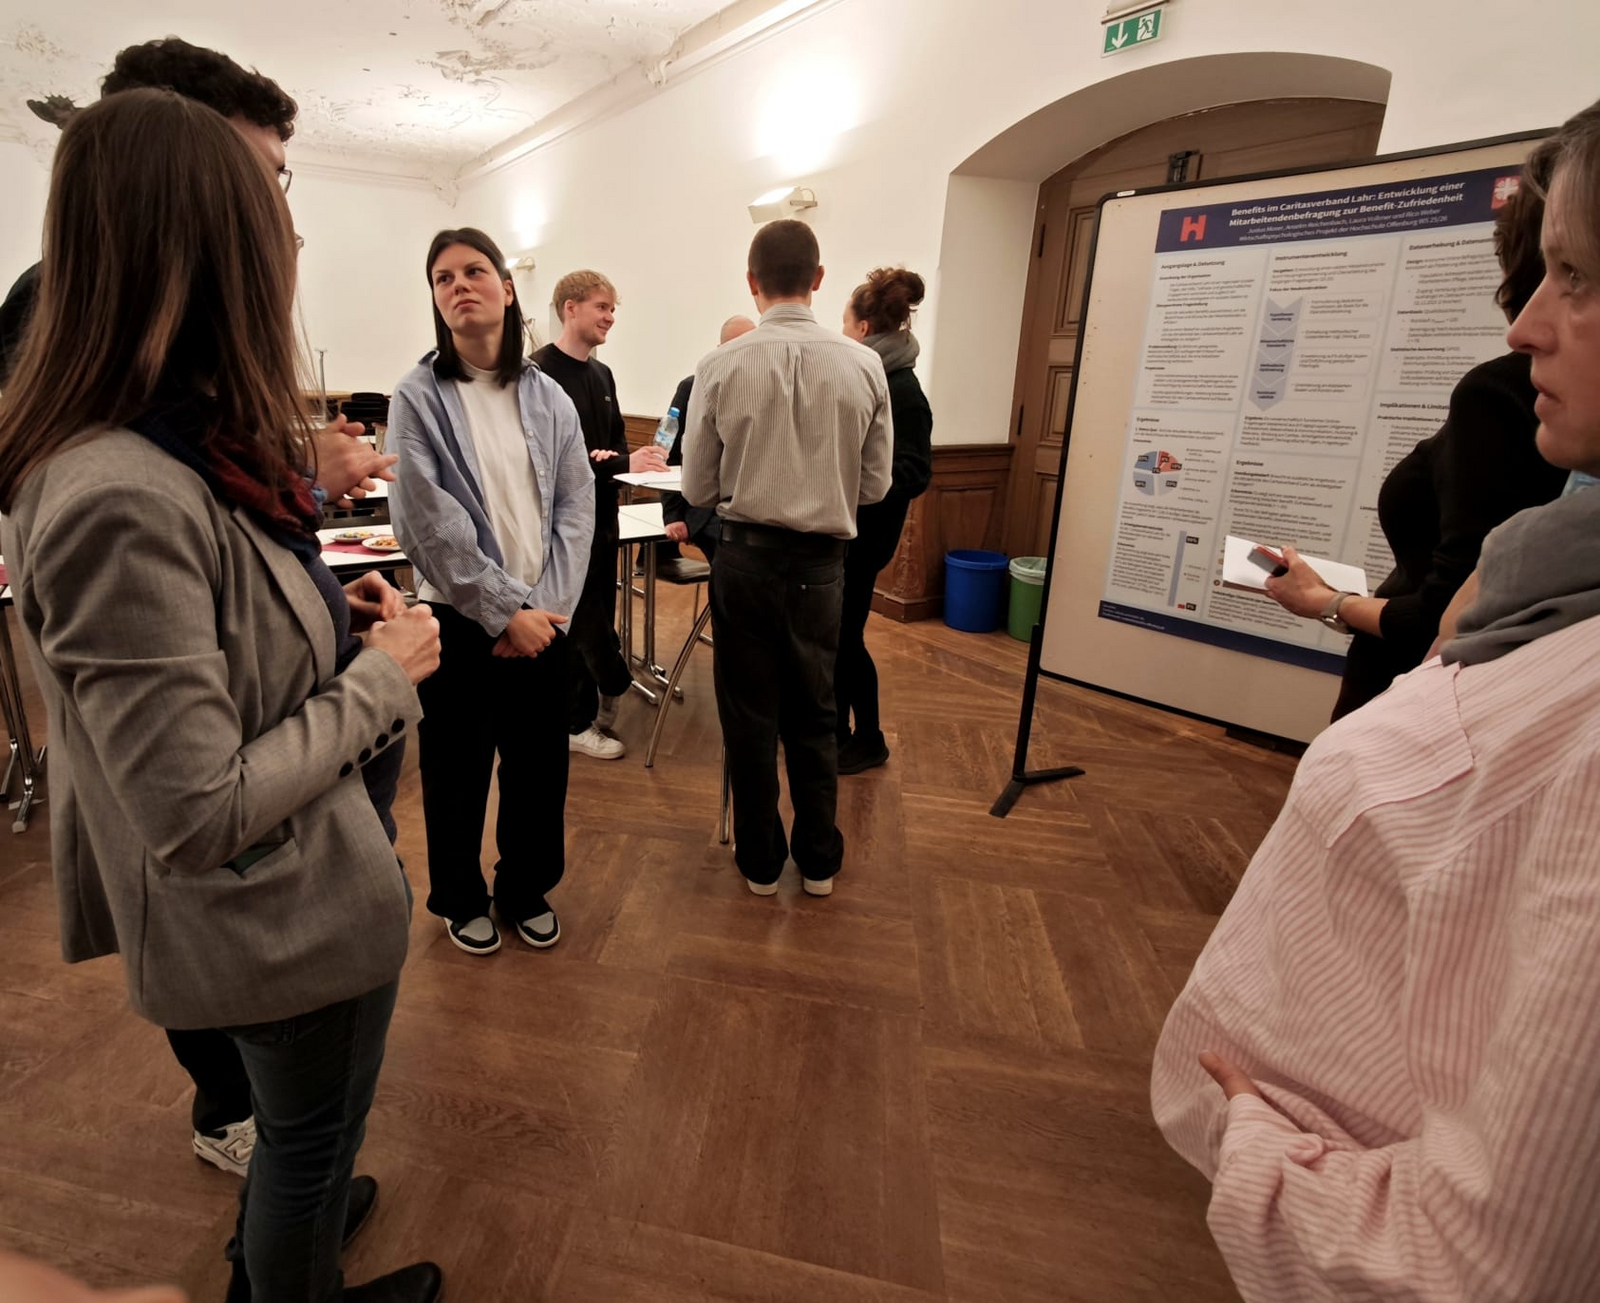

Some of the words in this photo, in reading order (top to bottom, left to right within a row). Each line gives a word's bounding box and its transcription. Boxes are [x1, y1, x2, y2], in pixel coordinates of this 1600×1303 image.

[1229, 209, 1341, 227] Mitarbeitendenbefragung
[1343, 207, 1359, 215] zur
[1360, 193, 1464, 213] Benefit-Zufriedenheit
[1231, 206, 1266, 216] Benefits
[1267, 204, 1278, 212] im
[1280, 195, 1349, 211] Caritasverband
[1351, 194, 1376, 203] Lahr:
[1378, 186, 1438, 200] Entwicklung
[1439, 182, 1466, 191] einer
